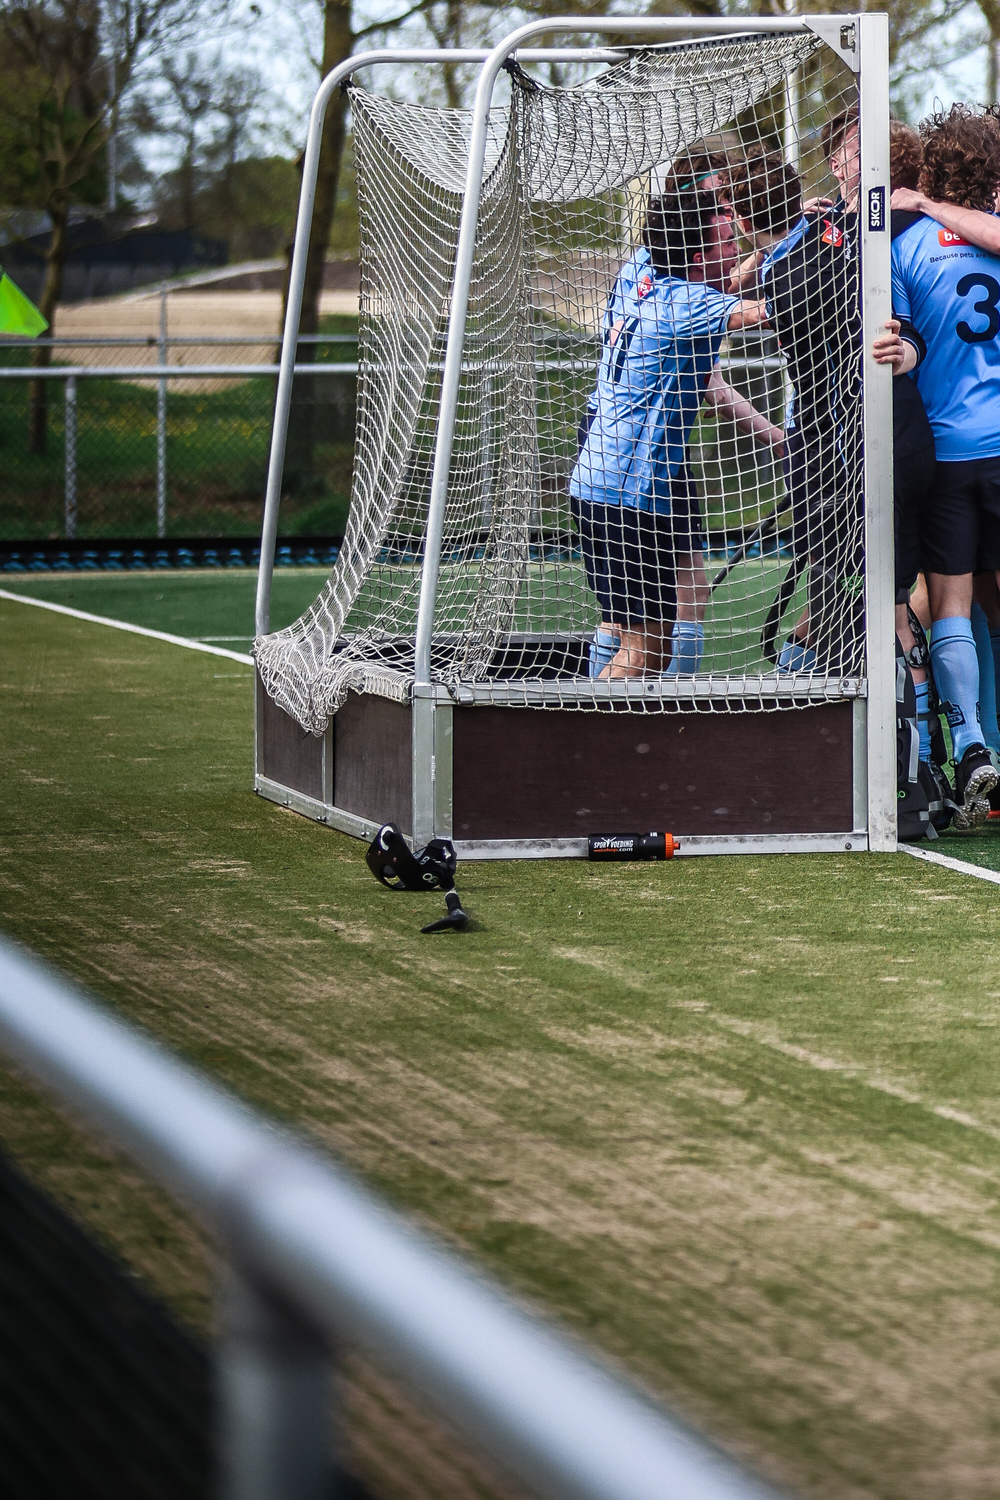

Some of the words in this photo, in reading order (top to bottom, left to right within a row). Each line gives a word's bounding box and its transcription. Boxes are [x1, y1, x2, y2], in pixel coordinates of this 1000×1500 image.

[871, 191, 880, 227] SKOR
[930, 252, 958, 264] Because
[956, 272, 1000, 344] 3
